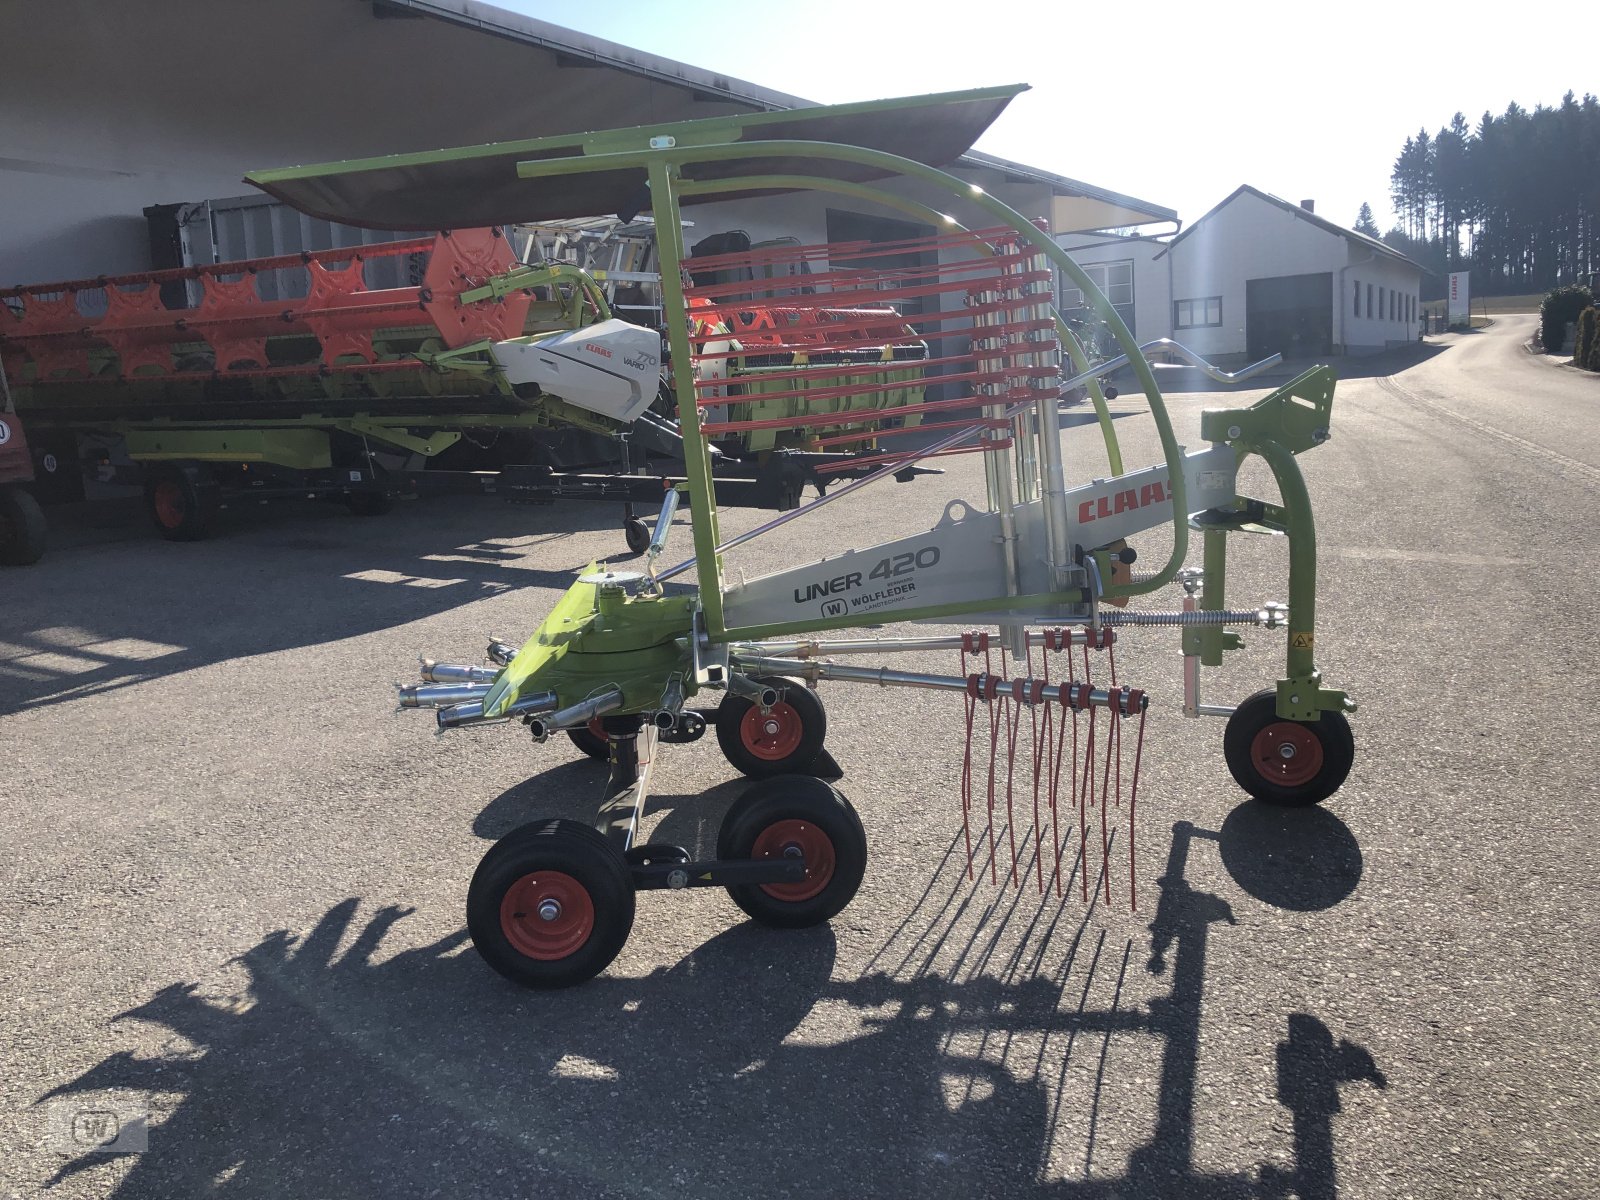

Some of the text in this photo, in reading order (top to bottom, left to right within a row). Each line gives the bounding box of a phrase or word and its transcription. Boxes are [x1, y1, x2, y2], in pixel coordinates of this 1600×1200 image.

[585, 343, 613, 358] CLAAS
[623, 356, 645, 371] VARIO
[794, 546, 941, 604] LINER 420
[851, 583, 916, 607] WÖLFLEDER
[826, 603, 842, 615] W
[864, 595, 906, 611] LANDTECHNIK
